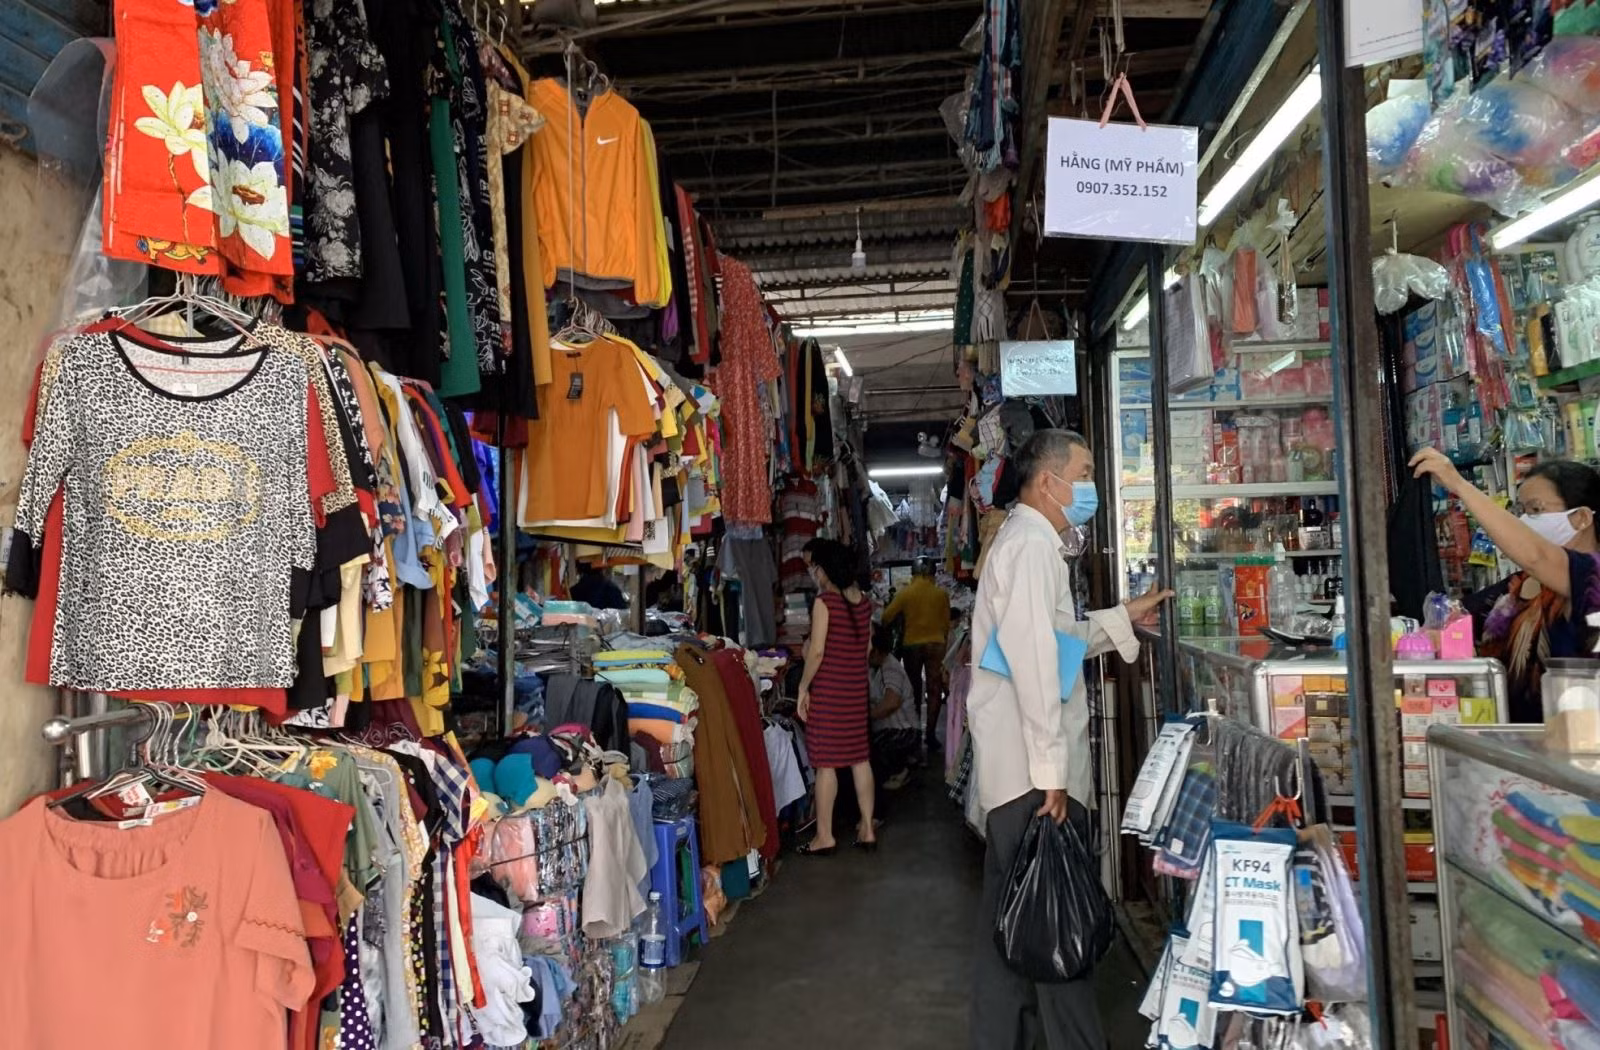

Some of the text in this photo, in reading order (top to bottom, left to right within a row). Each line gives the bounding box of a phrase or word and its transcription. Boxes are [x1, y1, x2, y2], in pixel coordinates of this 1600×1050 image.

[1105, 157, 1131, 173] (MỸ
[1076, 181, 1168, 198] 0907.352.152
[1232, 859, 1271, 874] KF94
[1243, 877, 1281, 892] Mask
